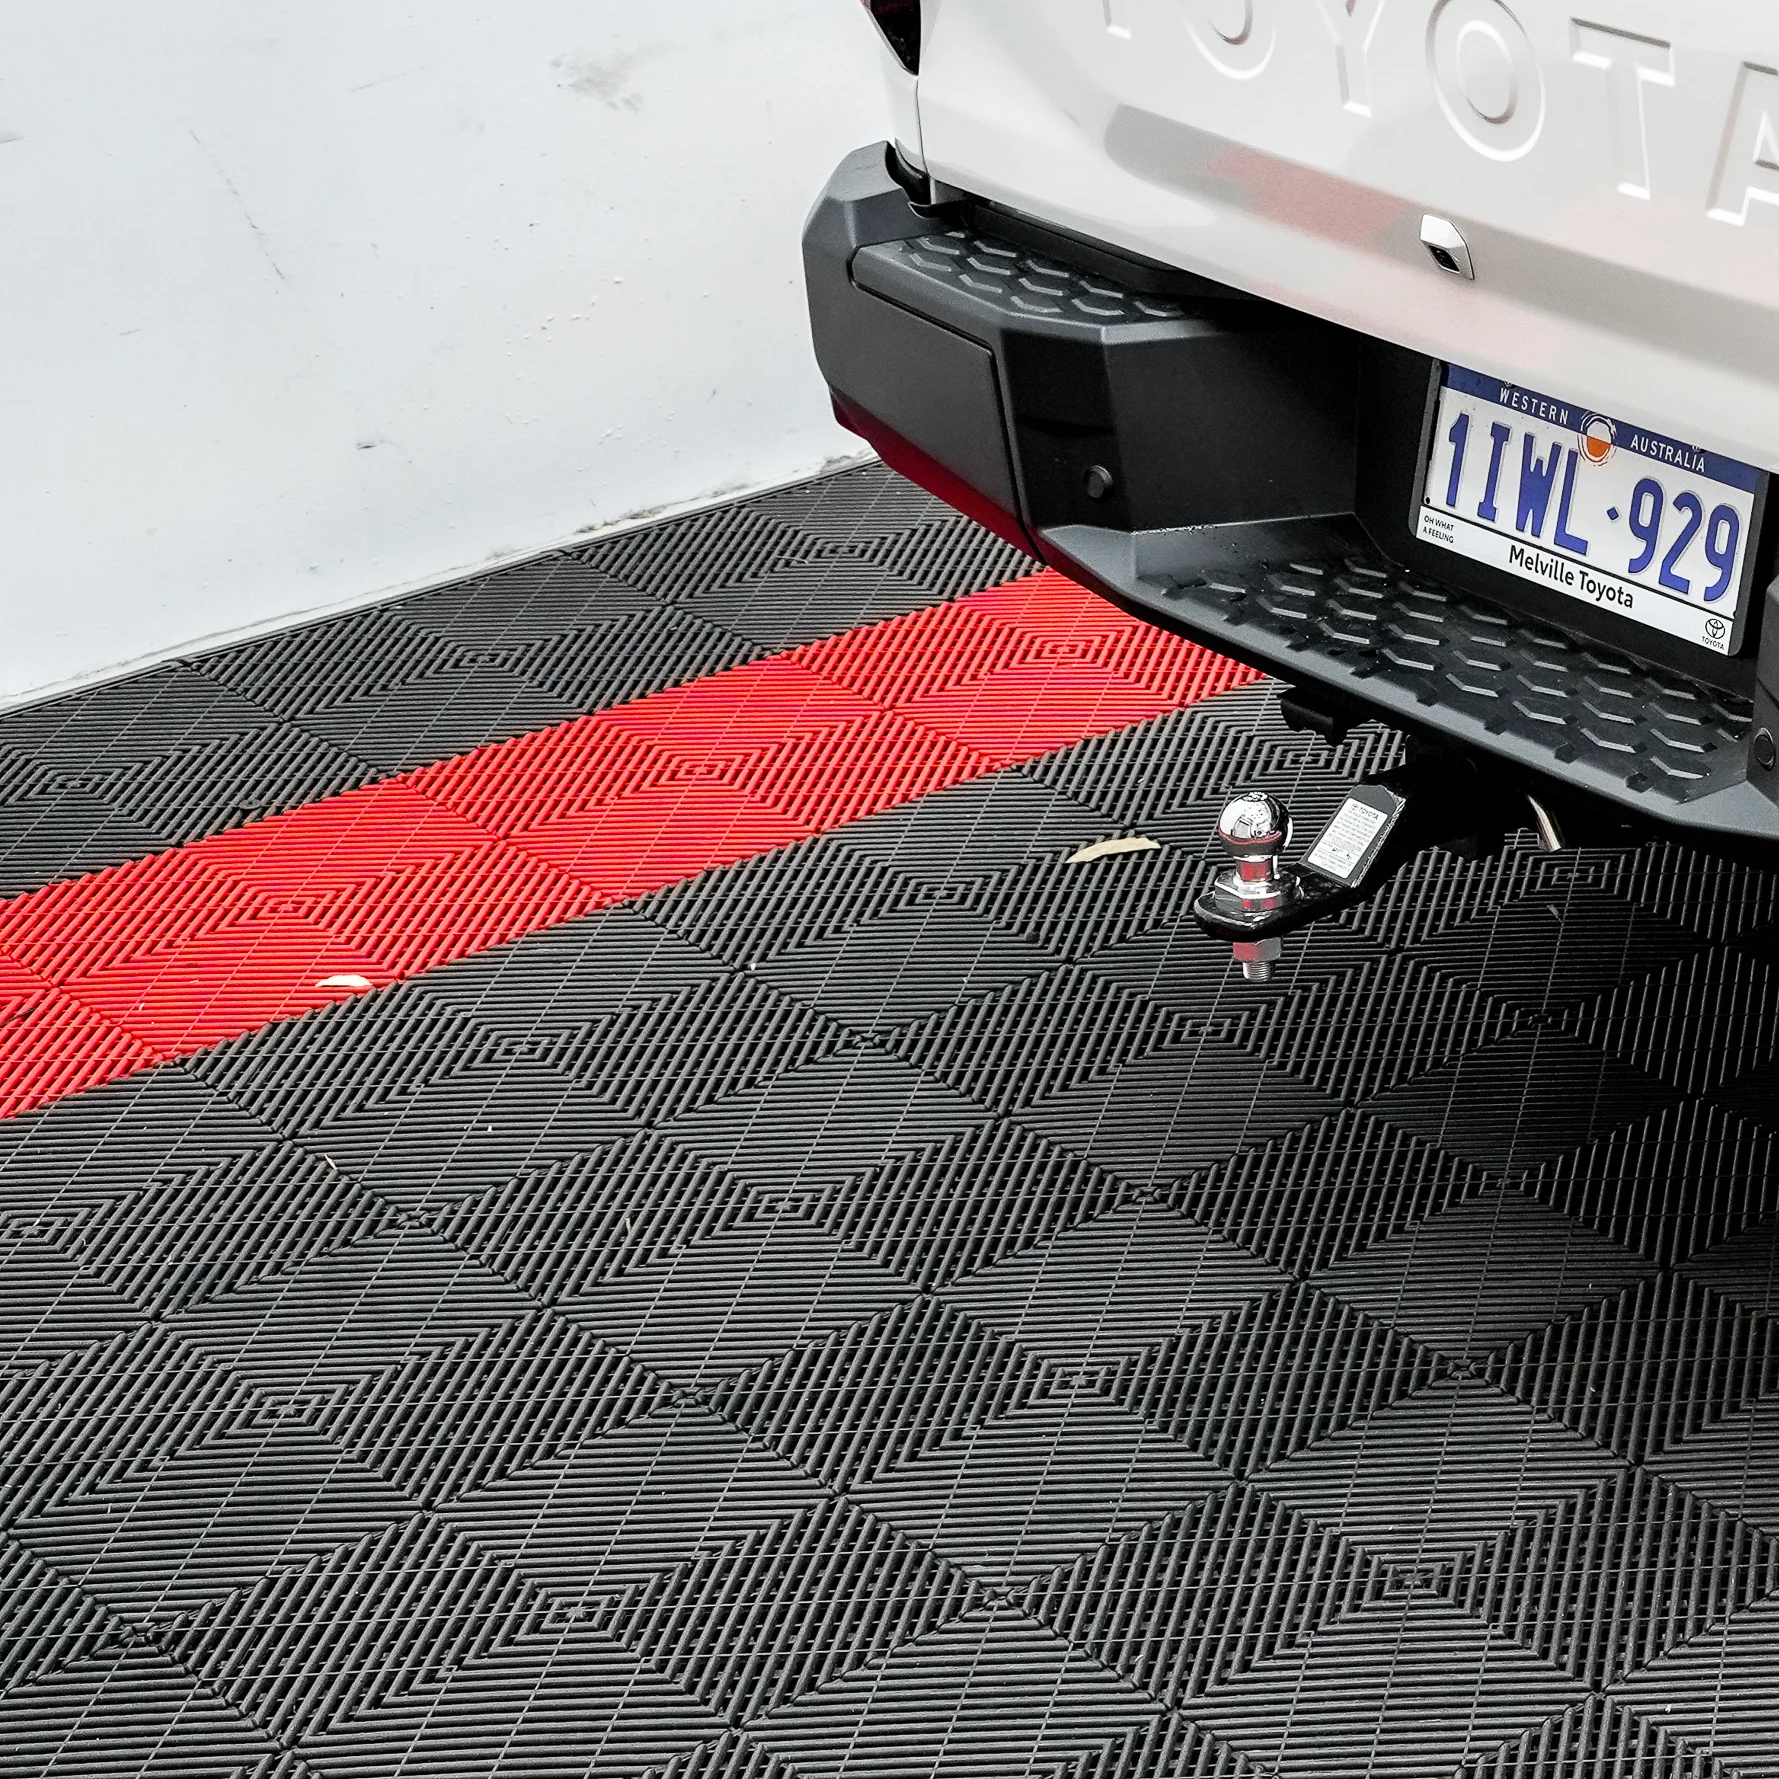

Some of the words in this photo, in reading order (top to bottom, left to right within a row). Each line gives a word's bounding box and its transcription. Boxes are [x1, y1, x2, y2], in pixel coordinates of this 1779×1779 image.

[1499, 387, 1569, 425] WESTERN
[1630, 434, 1706, 473] AUSTRALIA
[1424, 514, 1435, 525] OH
[1435, 519, 1455, 532] WHAT
[1422, 526, 1428, 534] A
[1429, 527, 1455, 544] FEELING
[1509, 545, 1575, 587] Melville
[1579, 572, 1634, 609] Toyota
[1701, 636, 1725, 651] TOYOTA
[1360, 806, 1380, 820] TOYOTA
